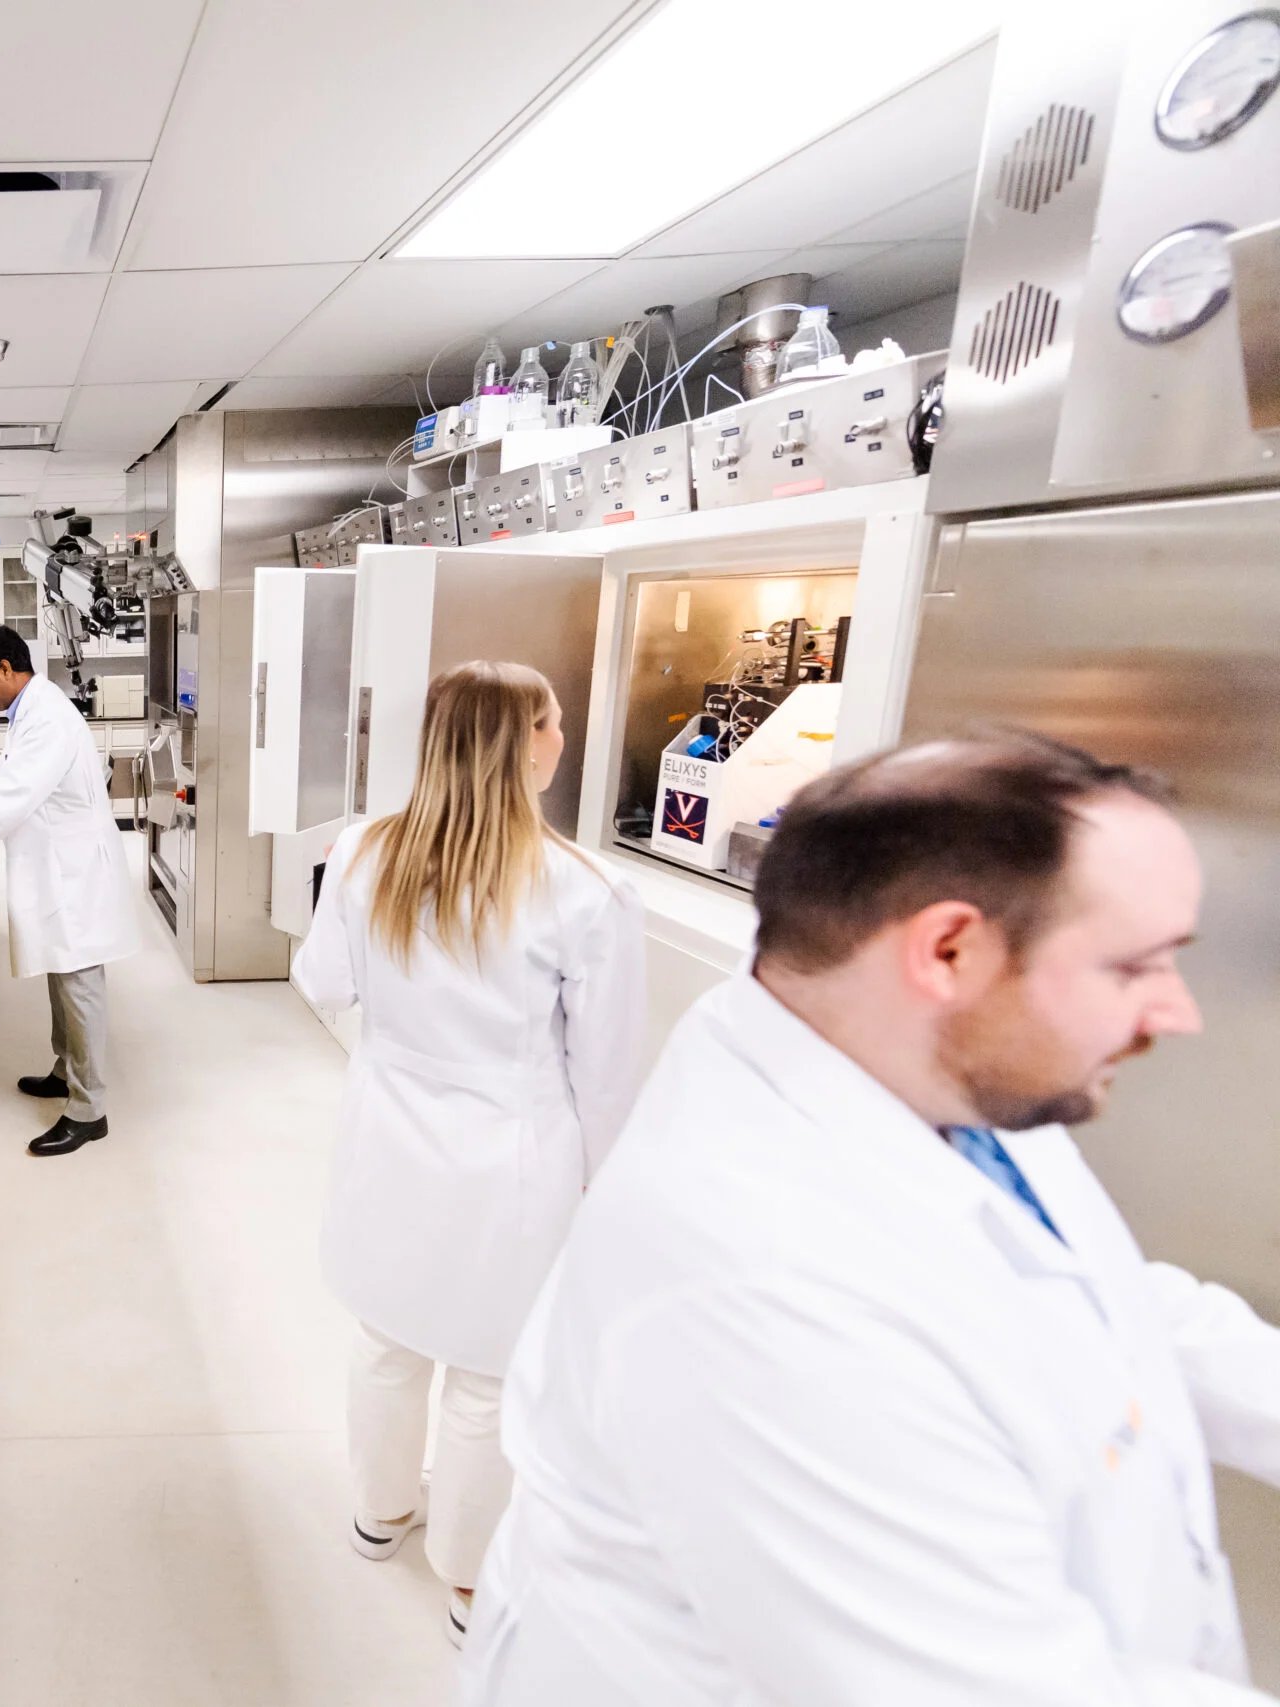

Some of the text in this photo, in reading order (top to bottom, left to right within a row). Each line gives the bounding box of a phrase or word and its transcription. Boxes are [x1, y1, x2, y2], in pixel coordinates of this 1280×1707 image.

[664, 758, 707, 779] ELIXYS
[663, 772, 680, 783] PURE
[686, 777, 706, 787] FORM
[674, 791, 700, 823] V
